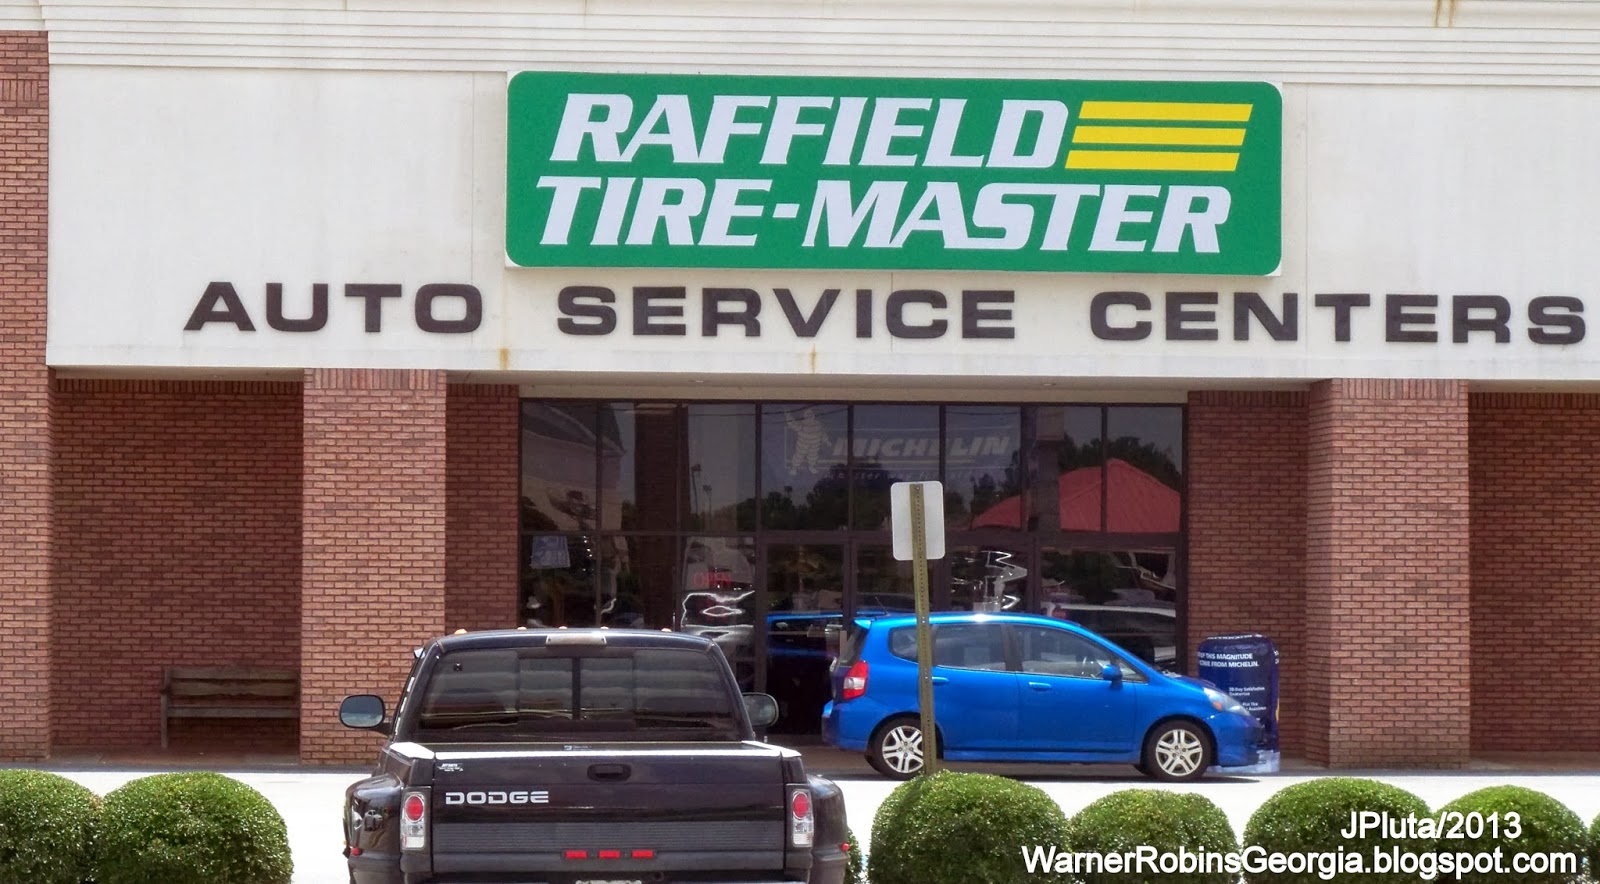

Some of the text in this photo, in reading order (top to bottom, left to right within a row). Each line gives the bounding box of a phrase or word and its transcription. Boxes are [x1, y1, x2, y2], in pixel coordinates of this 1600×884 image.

[550, 93, 1069, 169] RAFFIELD
[536, 176, 1232, 254] TIRE-MASTER
[184, 281, 1587, 346] AUTO SERVICE CENTERS
[445, 791, 549, 805] DODGE
